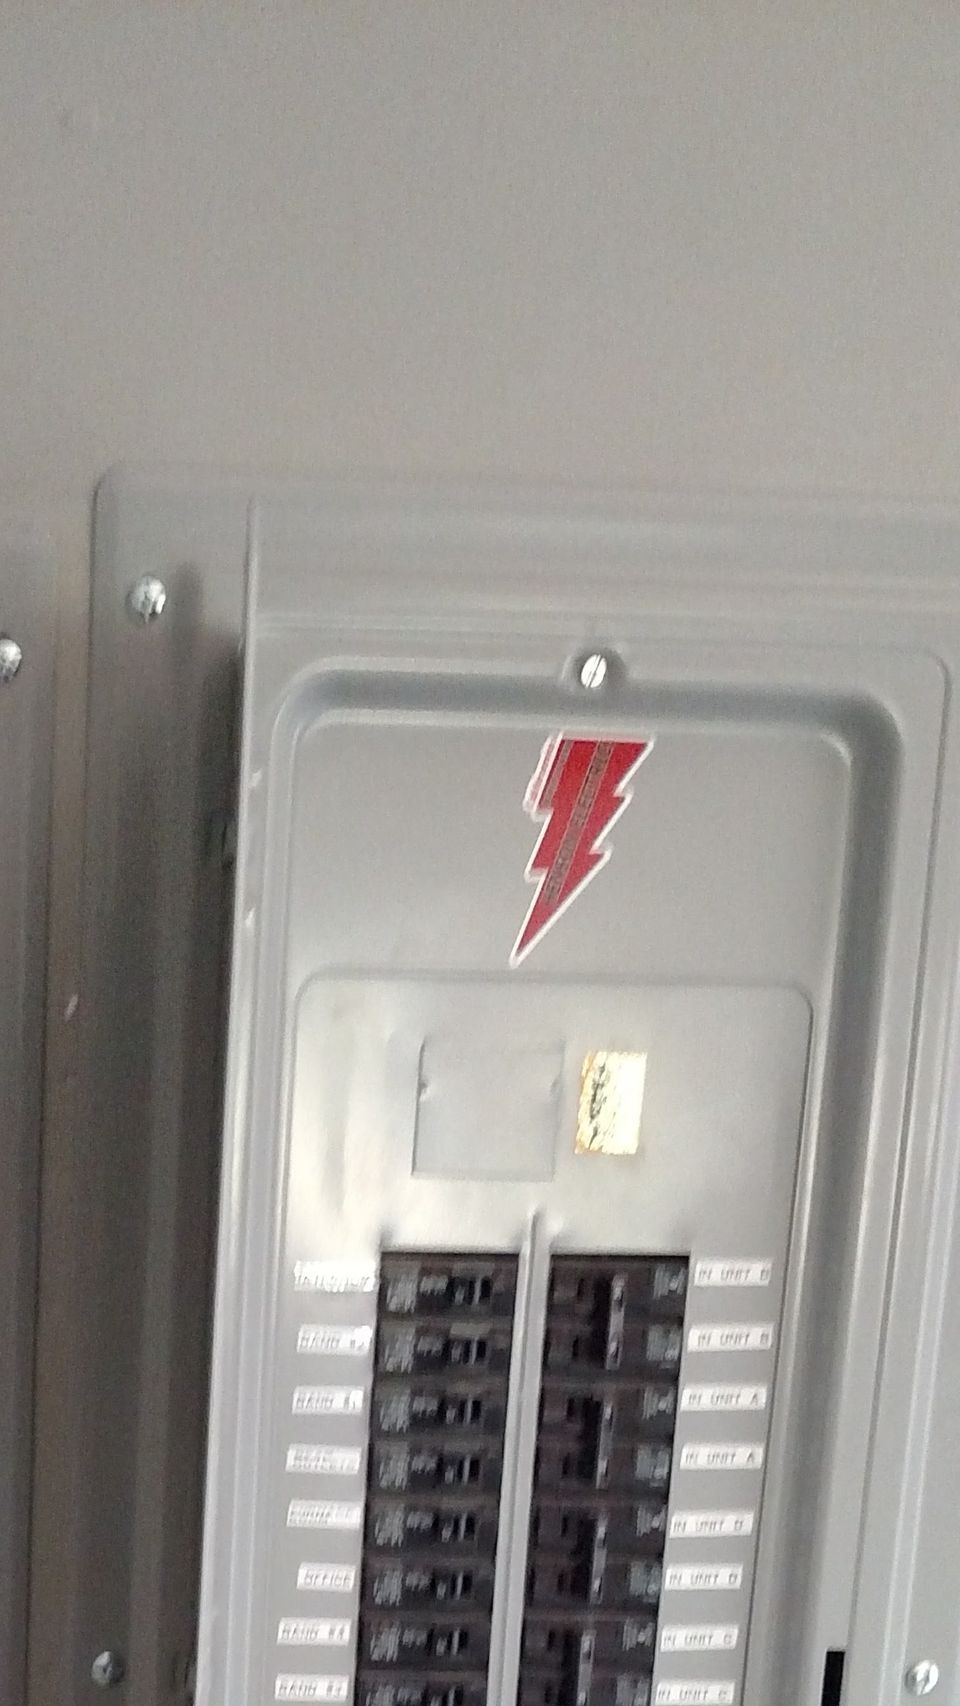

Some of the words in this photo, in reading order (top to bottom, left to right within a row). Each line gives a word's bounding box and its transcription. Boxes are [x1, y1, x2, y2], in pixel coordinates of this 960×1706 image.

[721, 1269, 750, 1281] UNIT
[720, 1332, 749, 1346] UNIT
[710, 1393, 740, 1406] UNIT
[707, 1452, 736, 1465] UNIT
[696, 1520, 724, 1532] UNIT
[691, 1574, 718, 1586] UNIT
[685, 1634, 713, 1646] UNIT
[680, 1690, 708, 1702] UNIT
